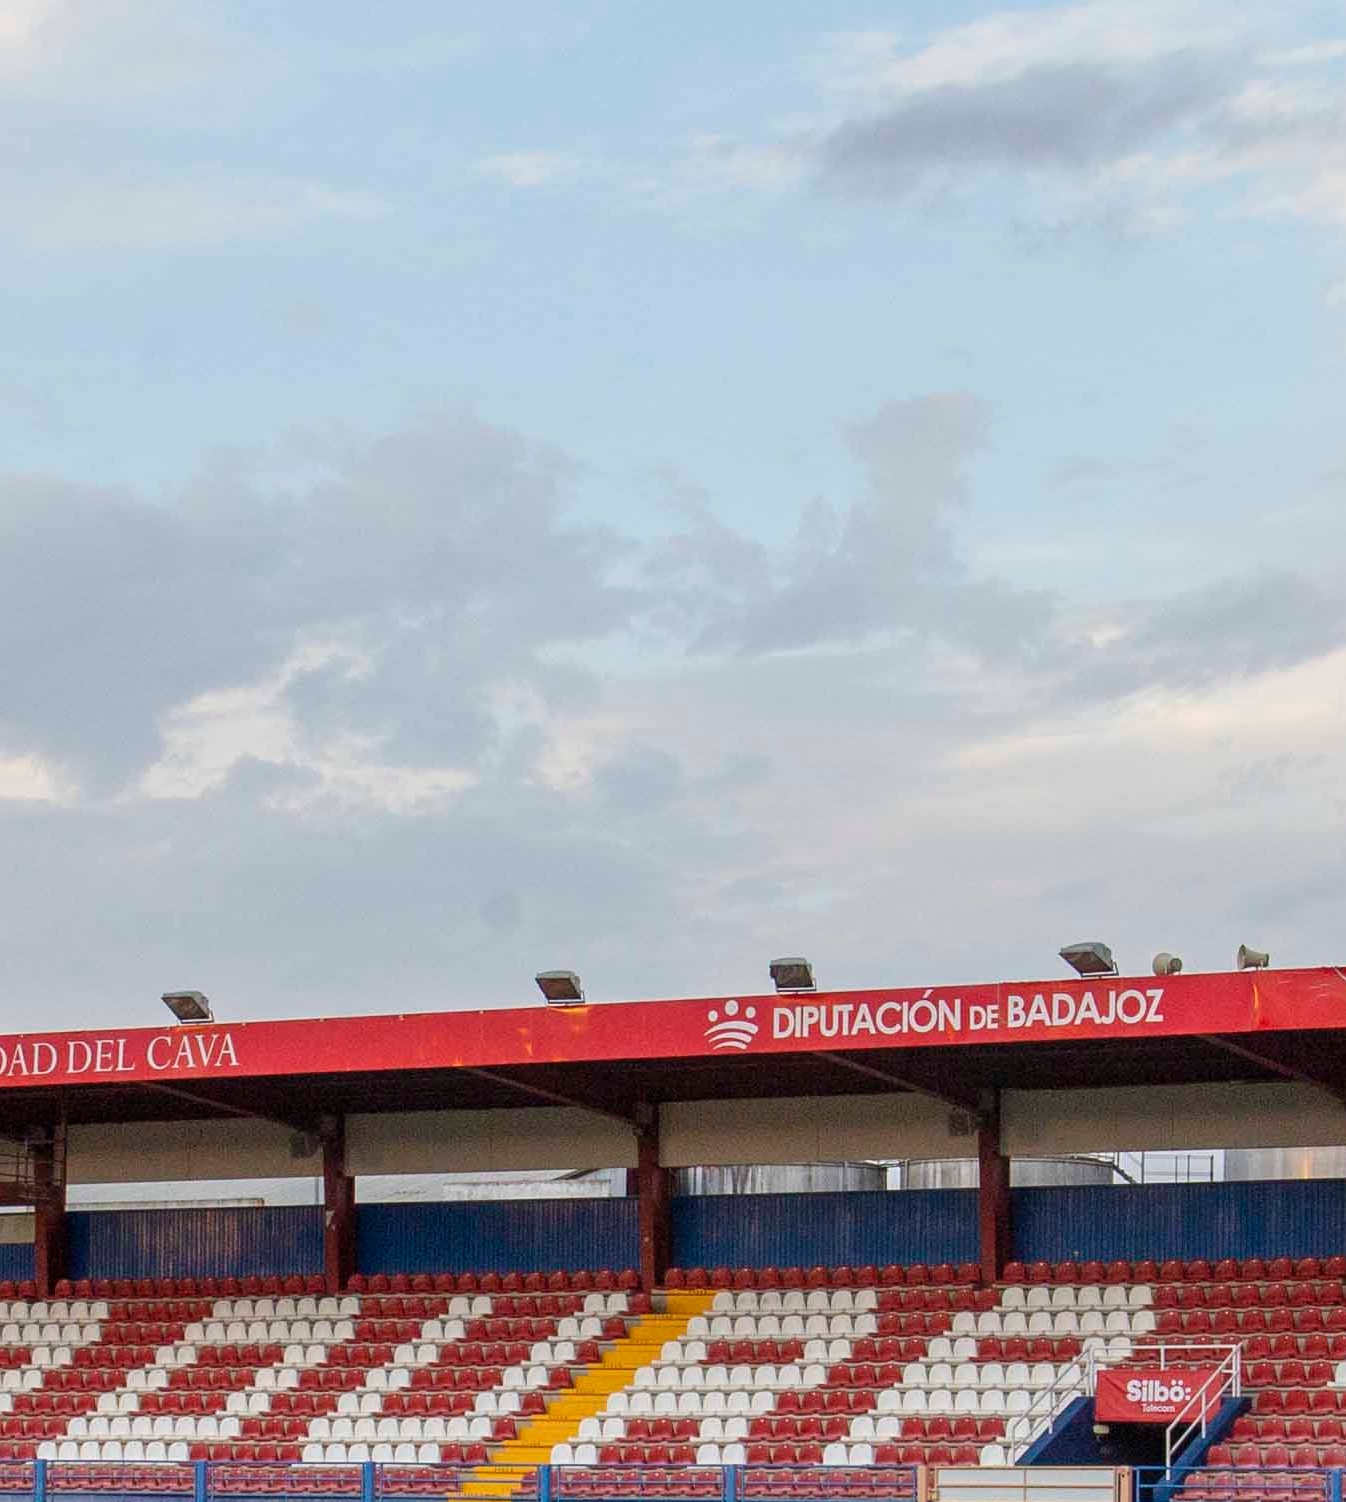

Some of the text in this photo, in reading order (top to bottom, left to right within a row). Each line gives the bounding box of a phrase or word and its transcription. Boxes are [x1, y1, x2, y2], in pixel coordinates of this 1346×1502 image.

[773, 988, 1164, 1039] DIPUTACIÓN DE BADAJOZ
[67, 1038, 135, 1074] DEL
[146, 1033, 240, 1070] CAVA
[1141, 1403, 1176, 1413] Telecom
